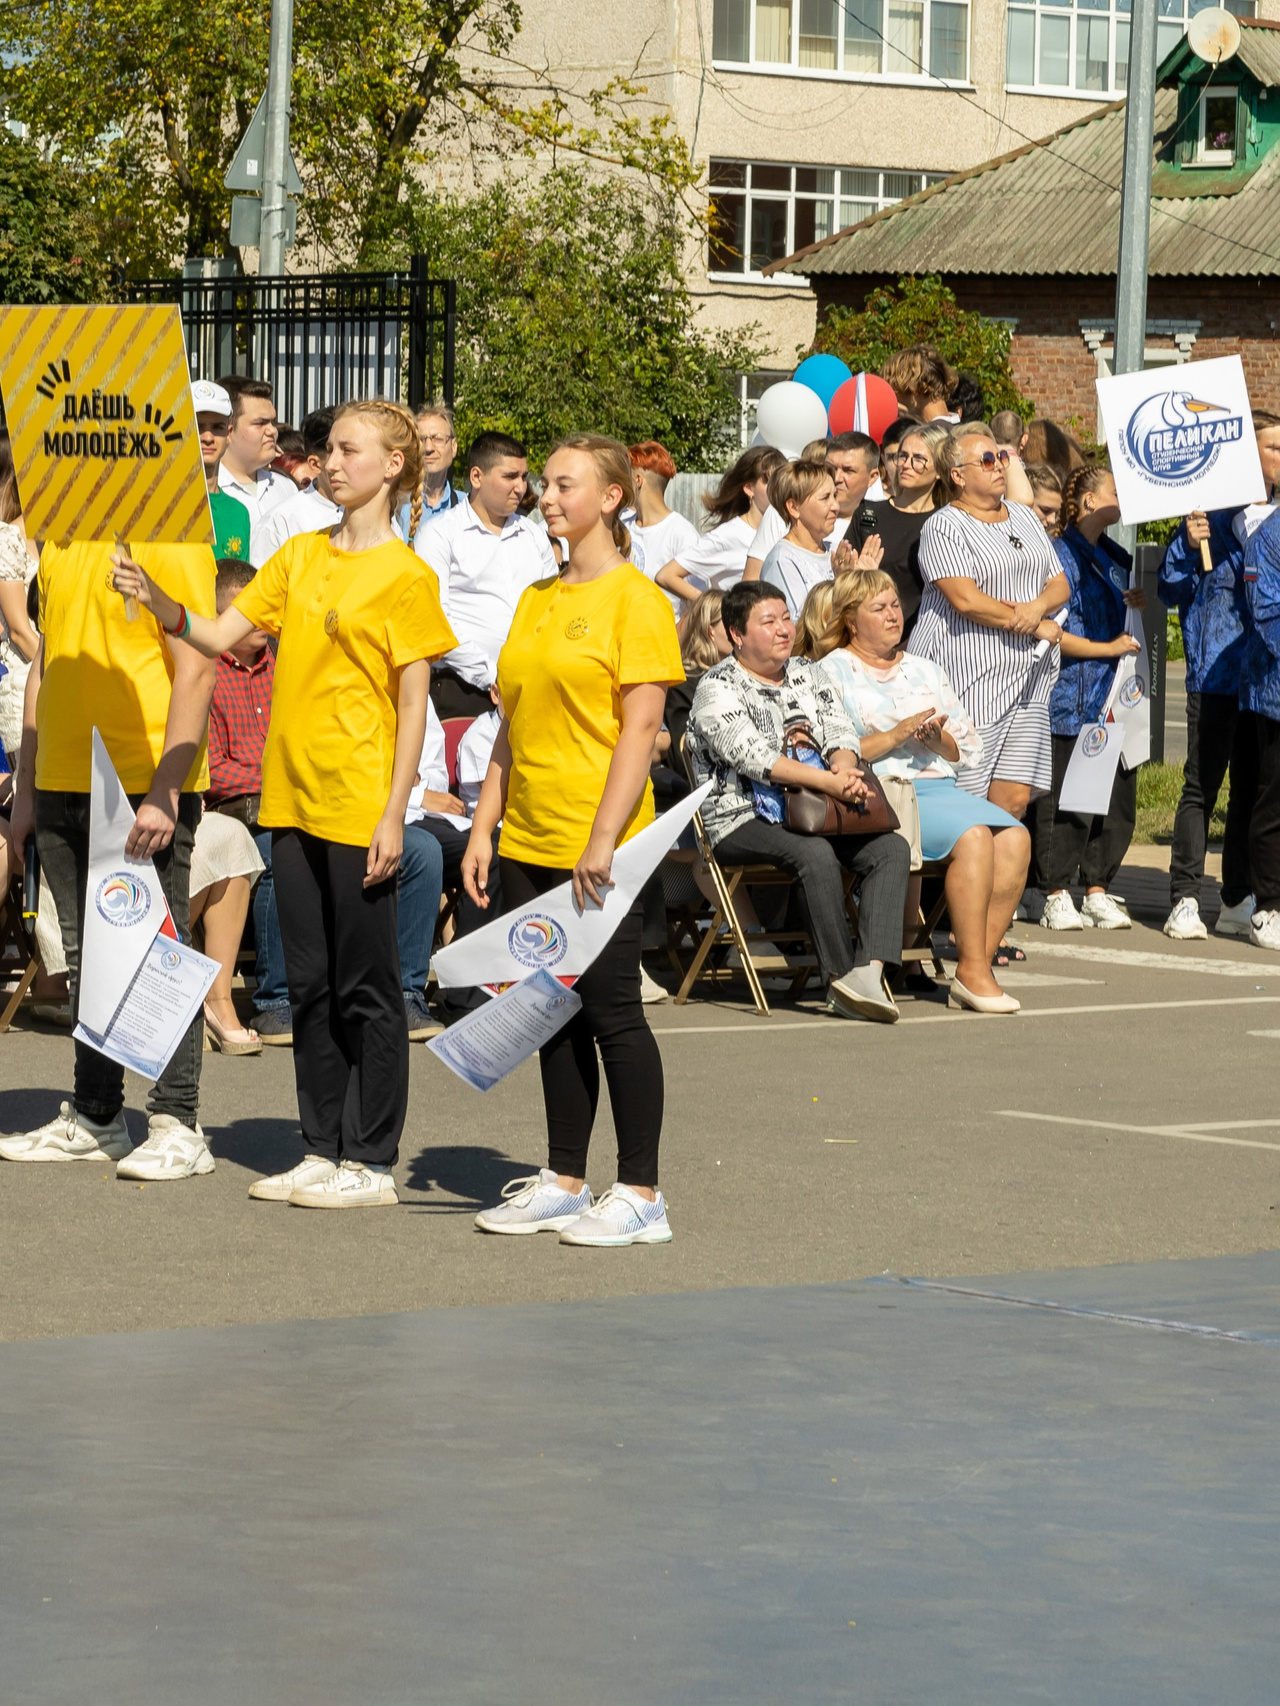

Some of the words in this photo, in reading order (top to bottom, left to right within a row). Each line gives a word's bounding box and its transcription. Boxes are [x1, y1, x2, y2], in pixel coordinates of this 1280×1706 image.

[63, 388, 136, 423] ДАЁШЬ
[44, 426, 163, 461] МОЛОДЁЖЬ
[1149, 419, 1240, 453] ПЕЛИКАН
[1151, 443, 1205, 459] СТУДЕНЧЕСКИЙ
[1152, 451, 1200, 466] СПОРТИВНЫЙ
[1125, 456, 1136, 469] МО
[1152, 463, 1171, 472] КЛУБ
